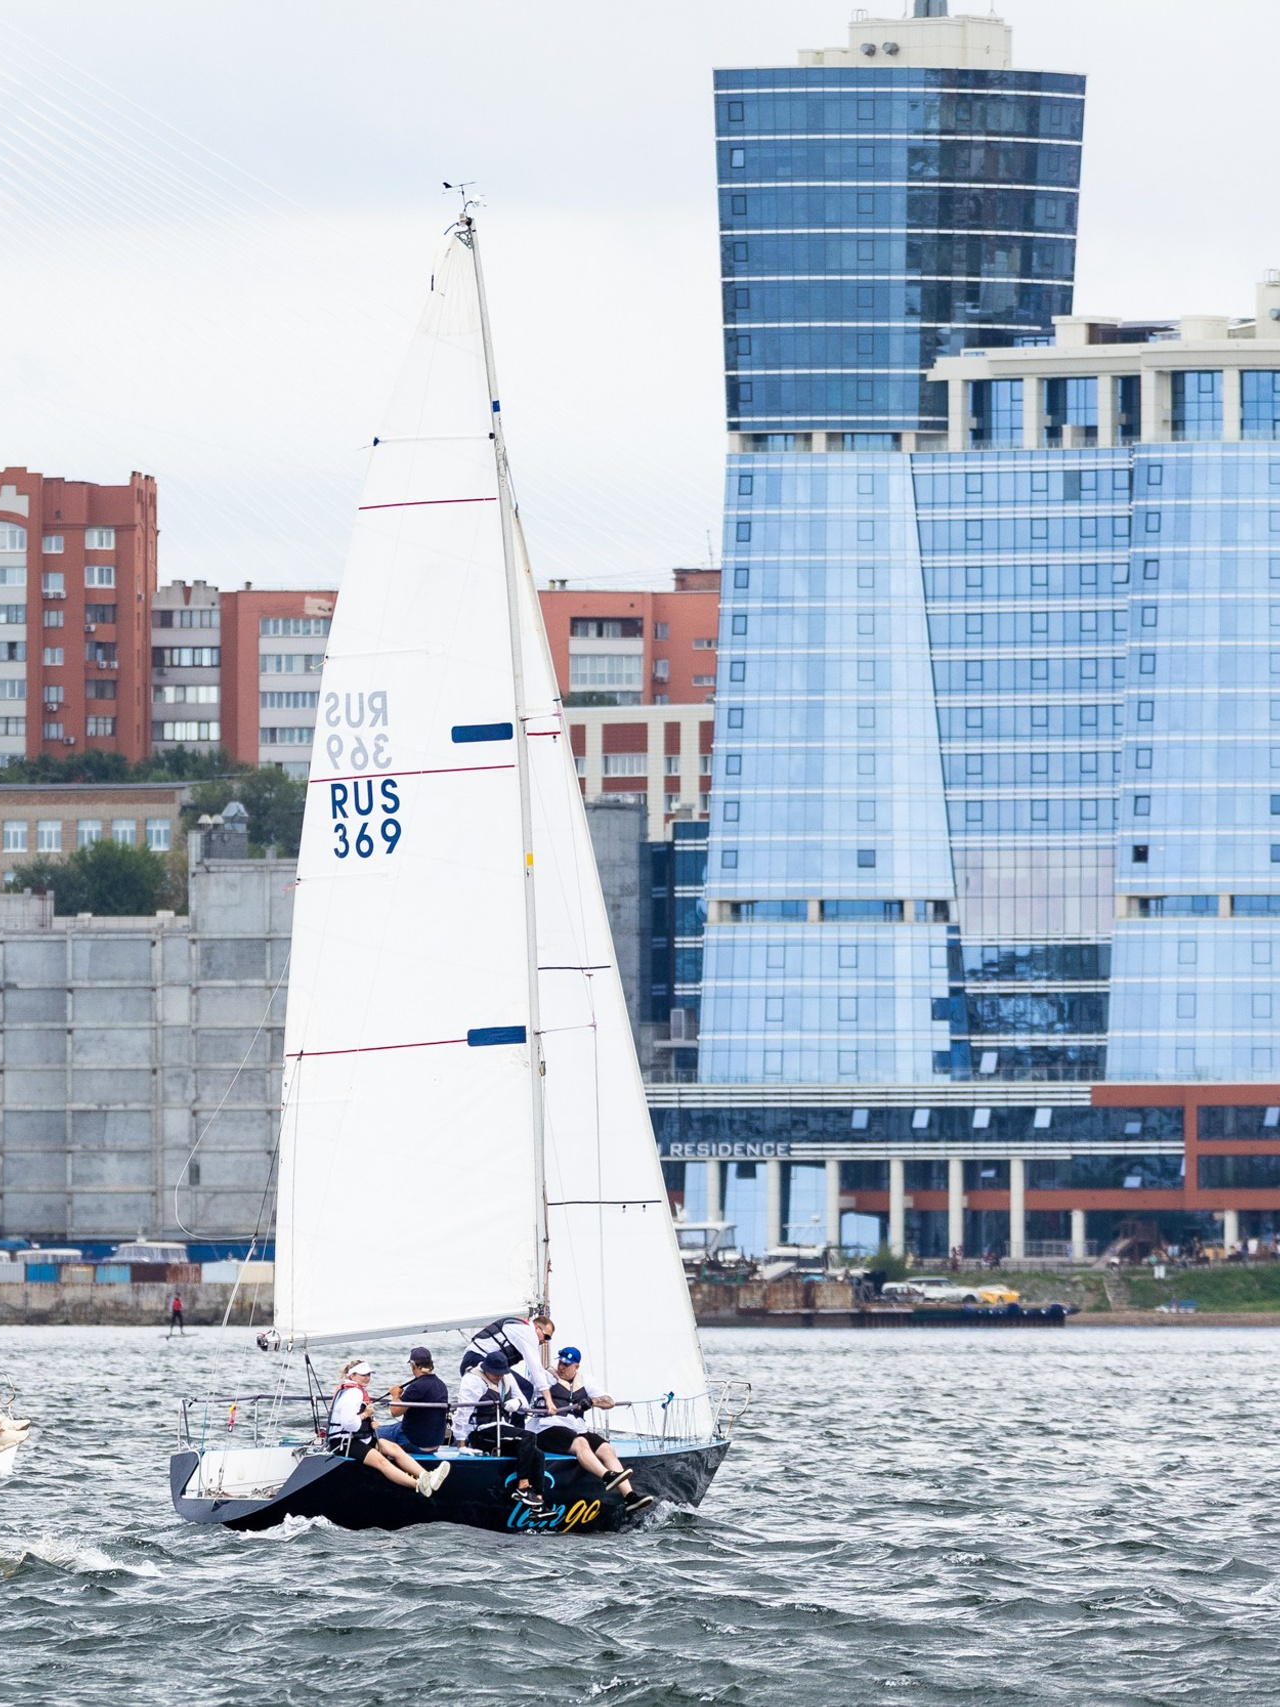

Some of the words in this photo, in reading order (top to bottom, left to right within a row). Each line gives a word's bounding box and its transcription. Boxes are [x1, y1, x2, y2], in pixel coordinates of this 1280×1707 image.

[330, 778, 400, 819] RUS
[333, 818, 402, 859] 369
[670, 1142, 790, 1157] RESIDENCE
